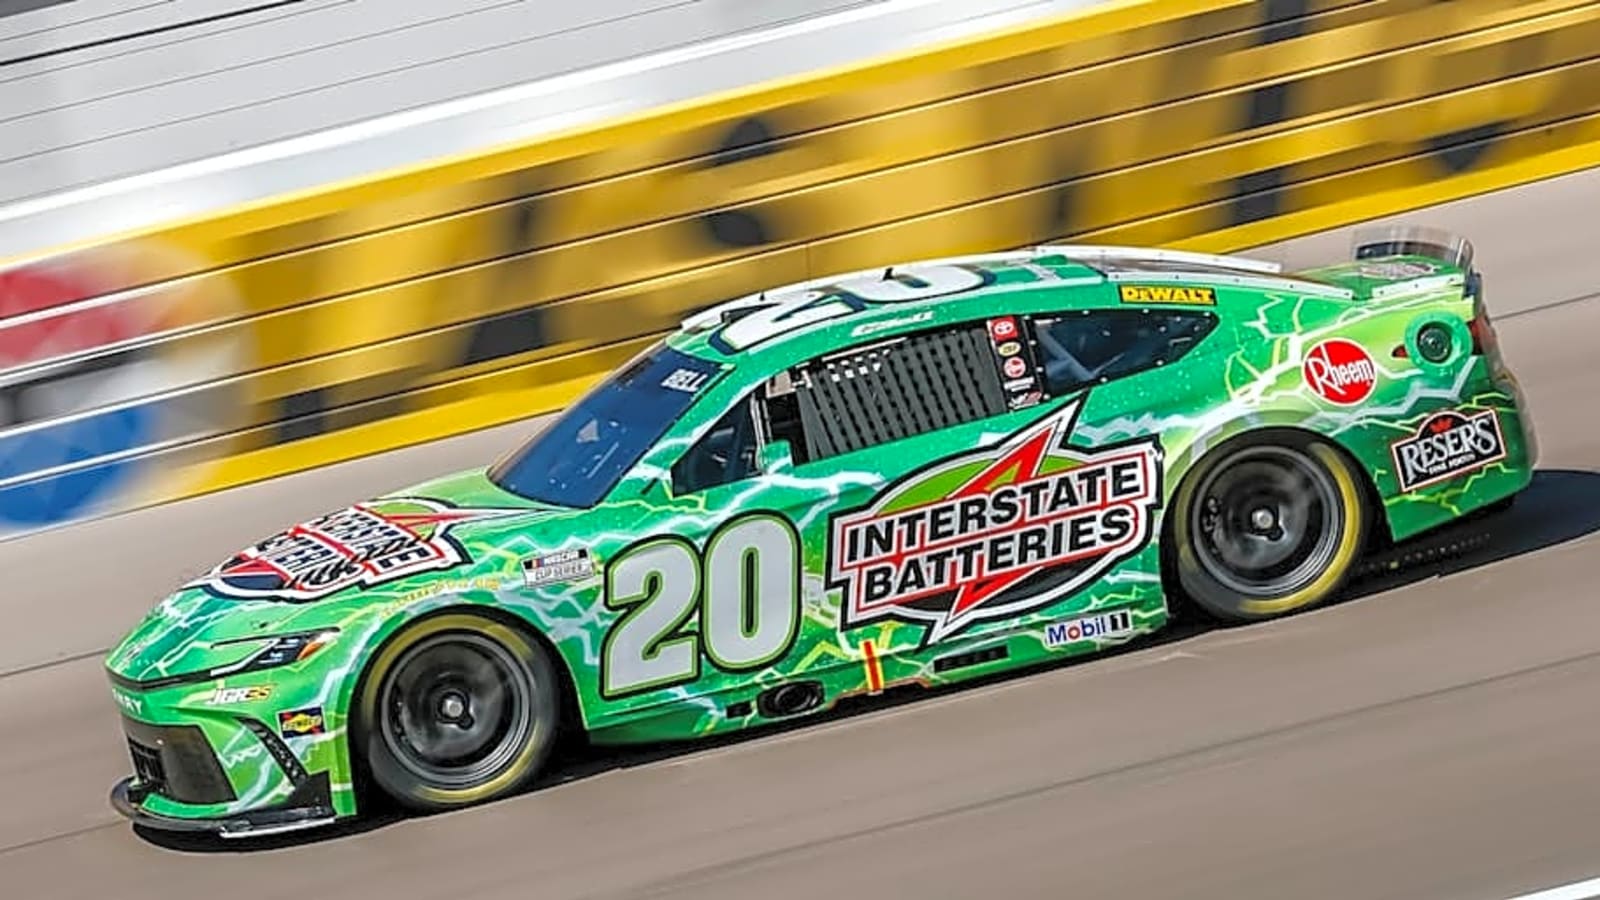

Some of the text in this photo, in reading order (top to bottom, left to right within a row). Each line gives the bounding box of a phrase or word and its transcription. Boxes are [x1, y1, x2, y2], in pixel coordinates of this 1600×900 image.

[1122, 285, 1215, 305] DEWALT
[1308, 343, 1375, 396] Rheem
[1400, 417, 1497, 484] RESER'S
[848, 461, 1141, 562] INTERSTATE
[864, 508, 1131, 602] BATTERIES
[604, 511, 801, 700] 20
[1048, 616, 1106, 644] Mobil
